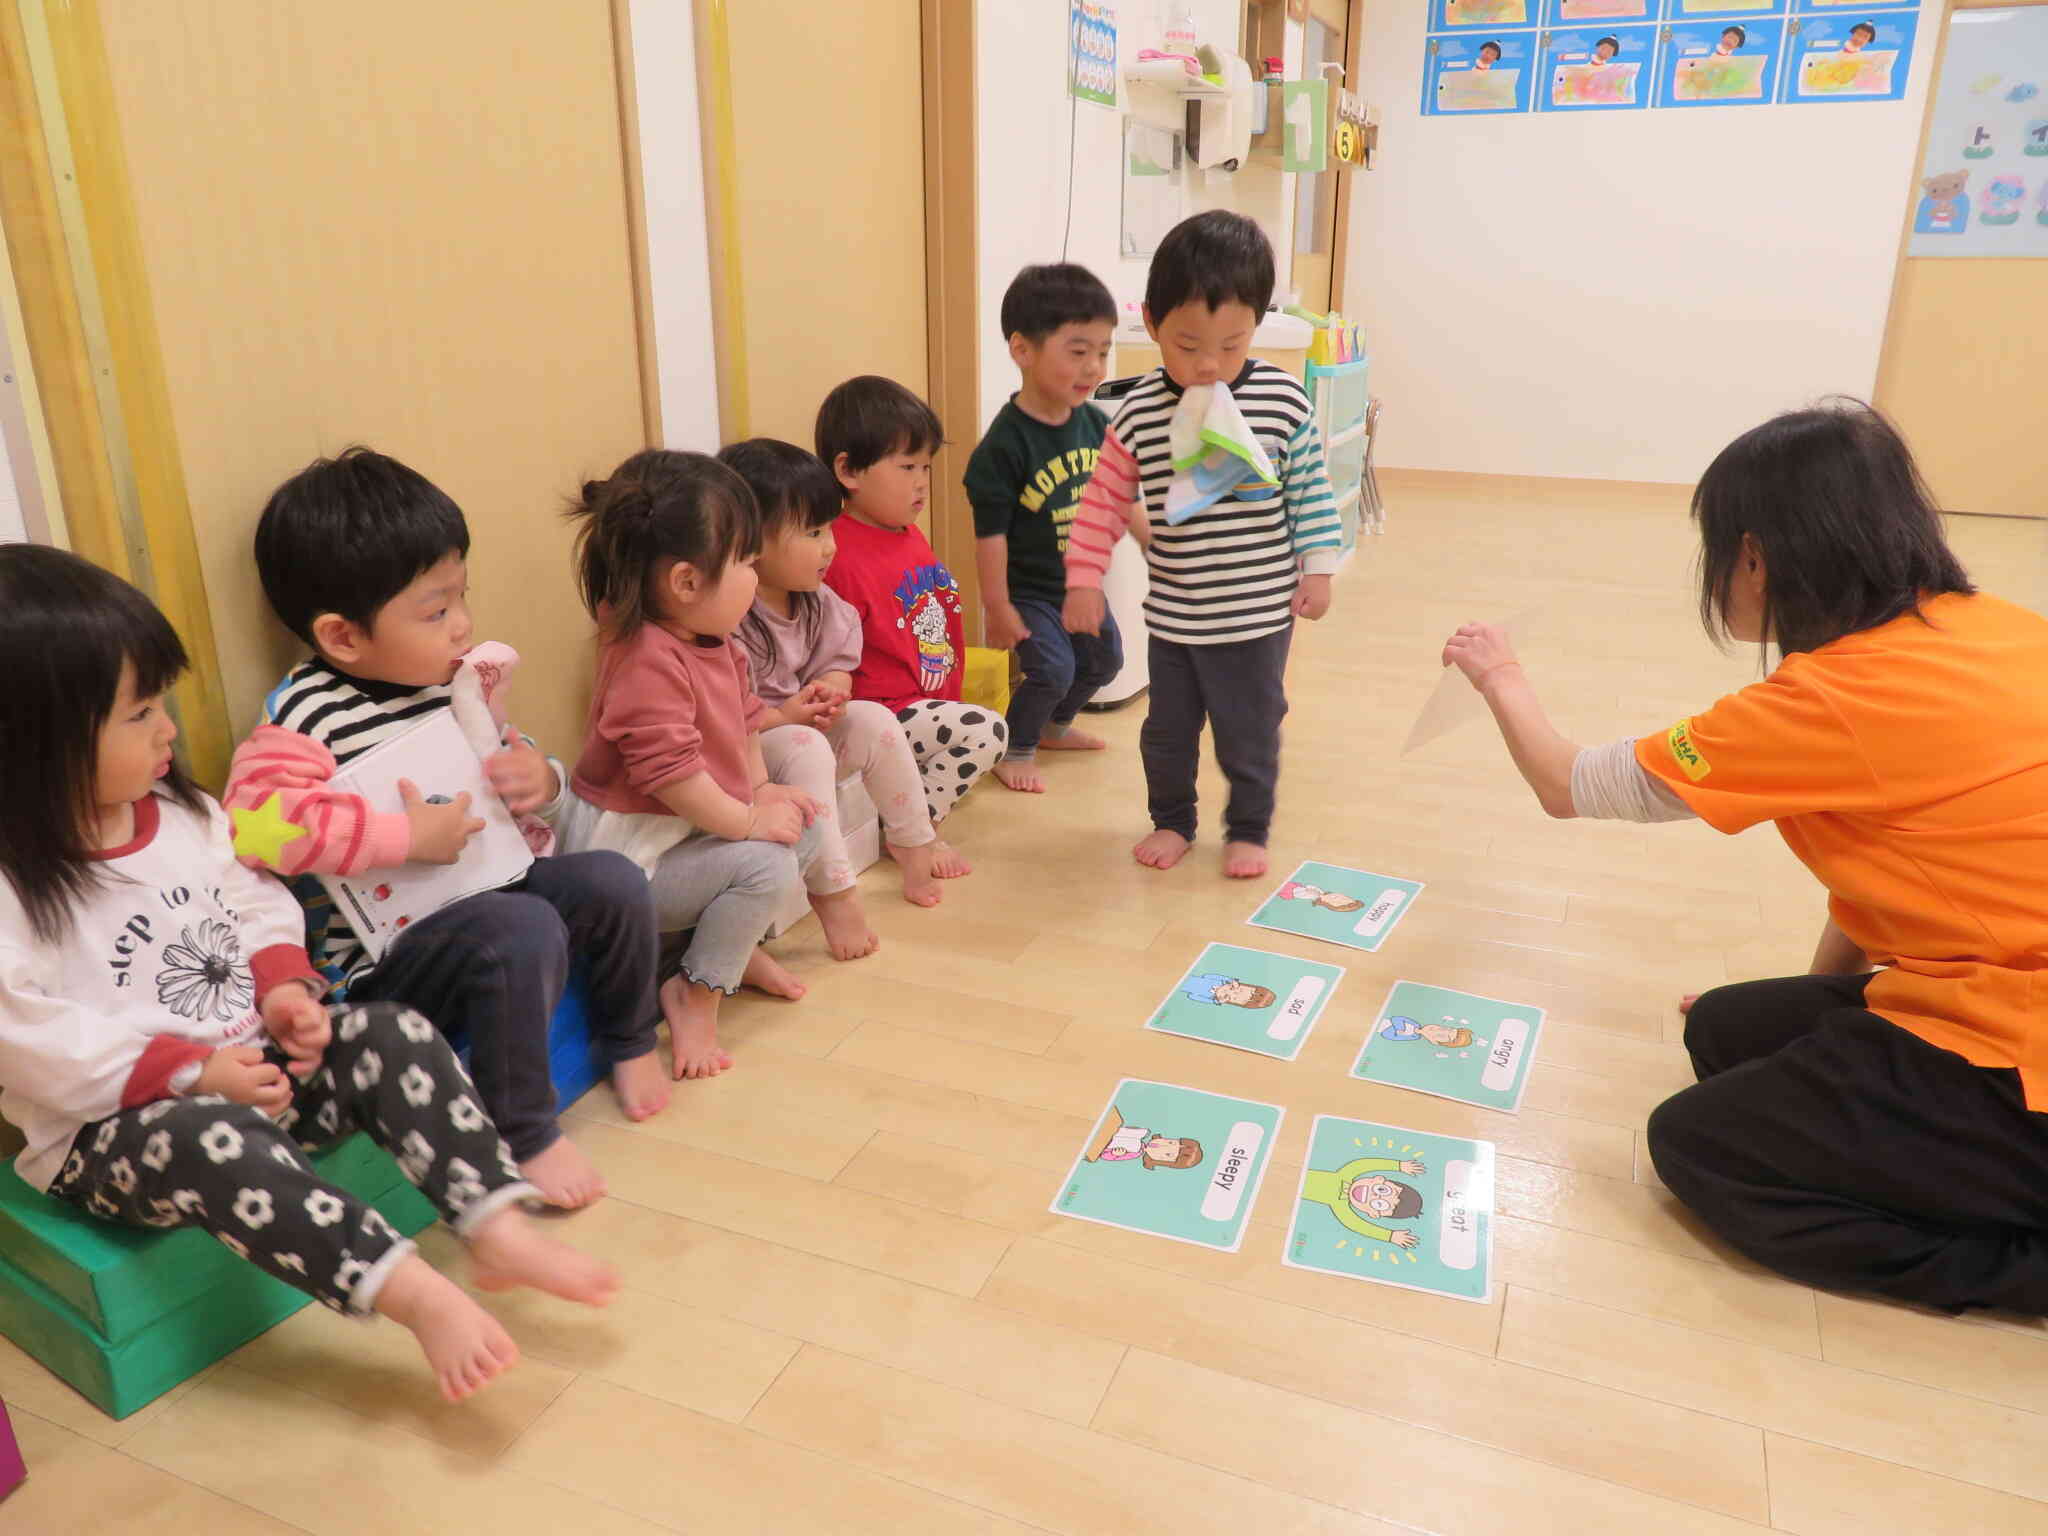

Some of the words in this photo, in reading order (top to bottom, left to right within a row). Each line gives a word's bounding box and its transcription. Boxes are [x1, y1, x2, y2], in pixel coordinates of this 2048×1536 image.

[1341, 131, 1349, 160] 5
[1367, 902, 1395, 922] happy
[108, 914, 154, 987] step
[160, 886, 190, 910] to
[1288, 999, 1305, 1017] sad
[1491, 1038, 1514, 1068] angry
[1214, 1147, 1249, 1191] sleepy
[1447, 1190, 1470, 1232] geat
